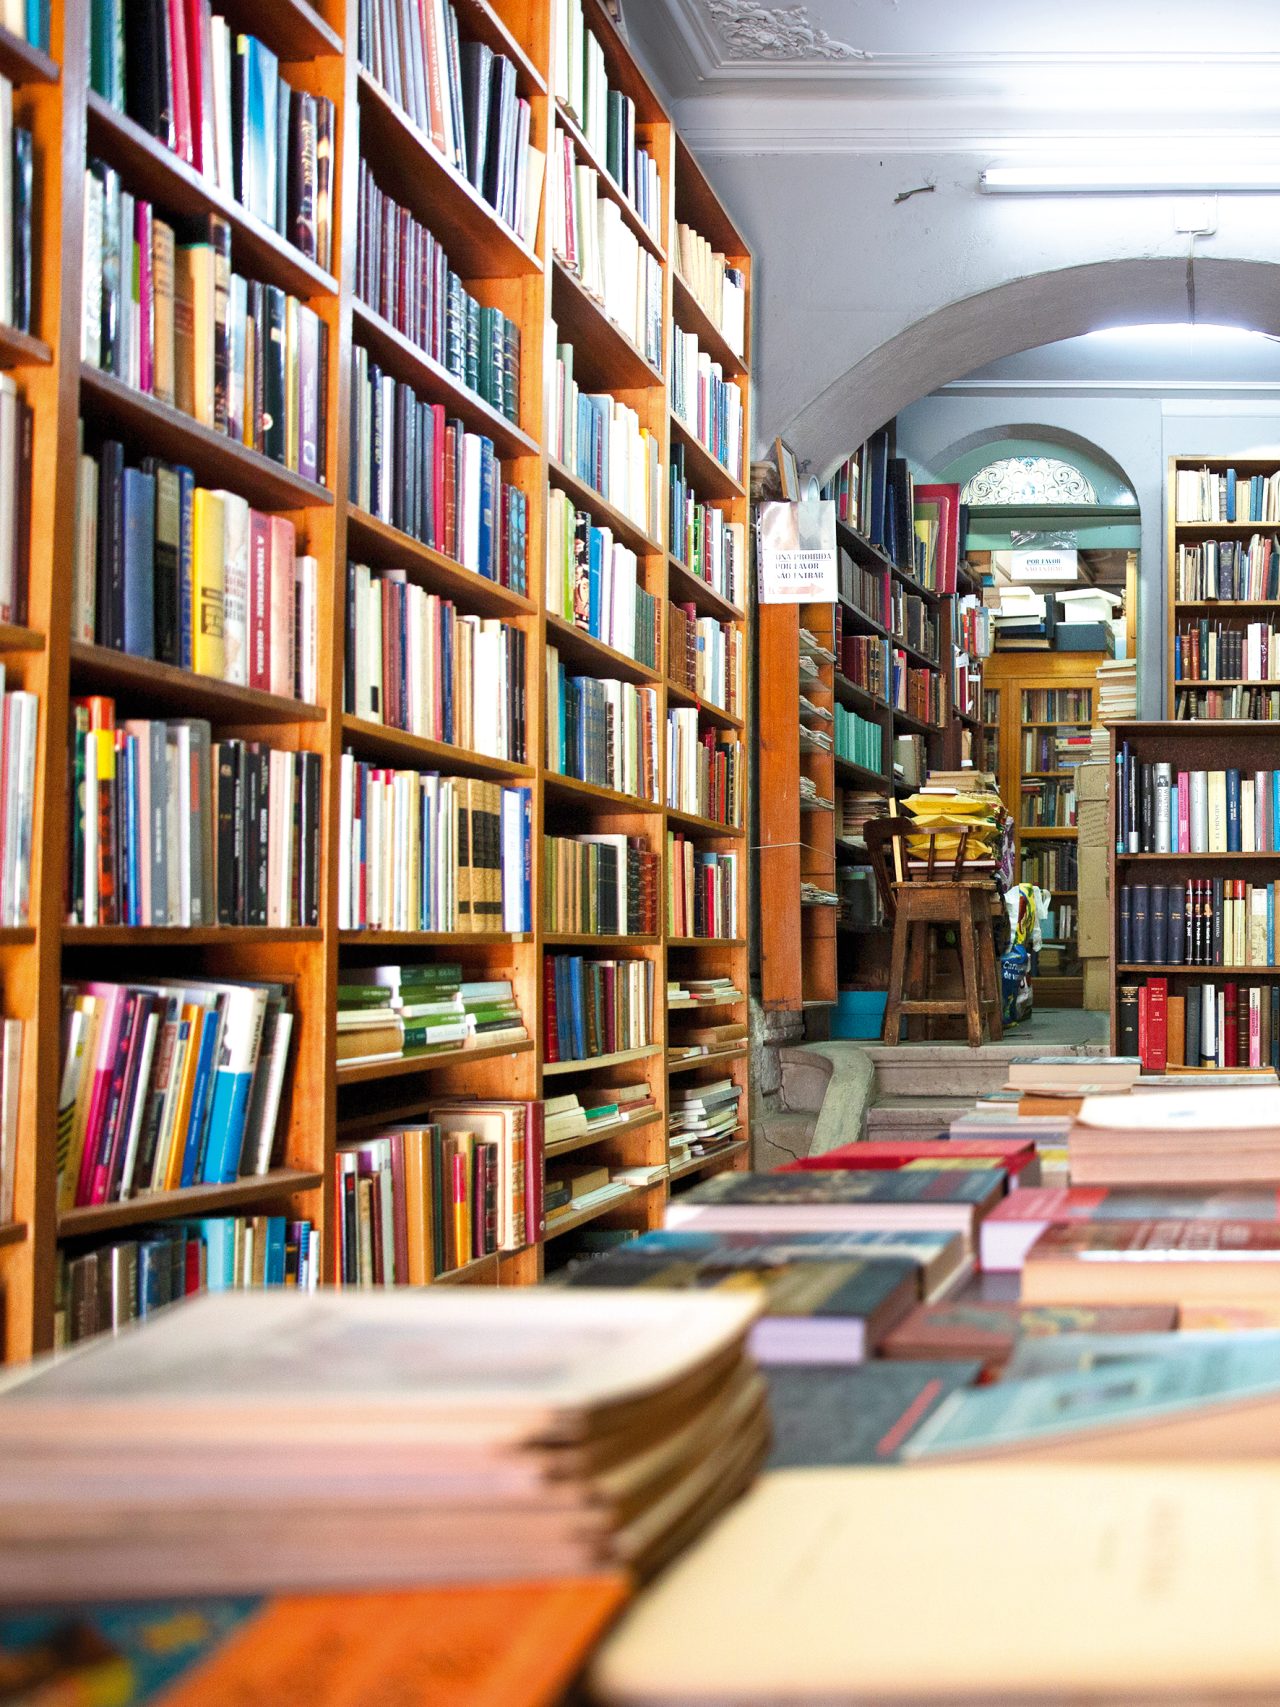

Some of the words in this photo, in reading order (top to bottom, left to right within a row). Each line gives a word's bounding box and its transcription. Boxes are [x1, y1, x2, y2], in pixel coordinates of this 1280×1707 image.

[257, 535, 265, 545] A
[257, 630, 265, 674] GUERRA
[260, 808, 268, 843] MOSSAD
